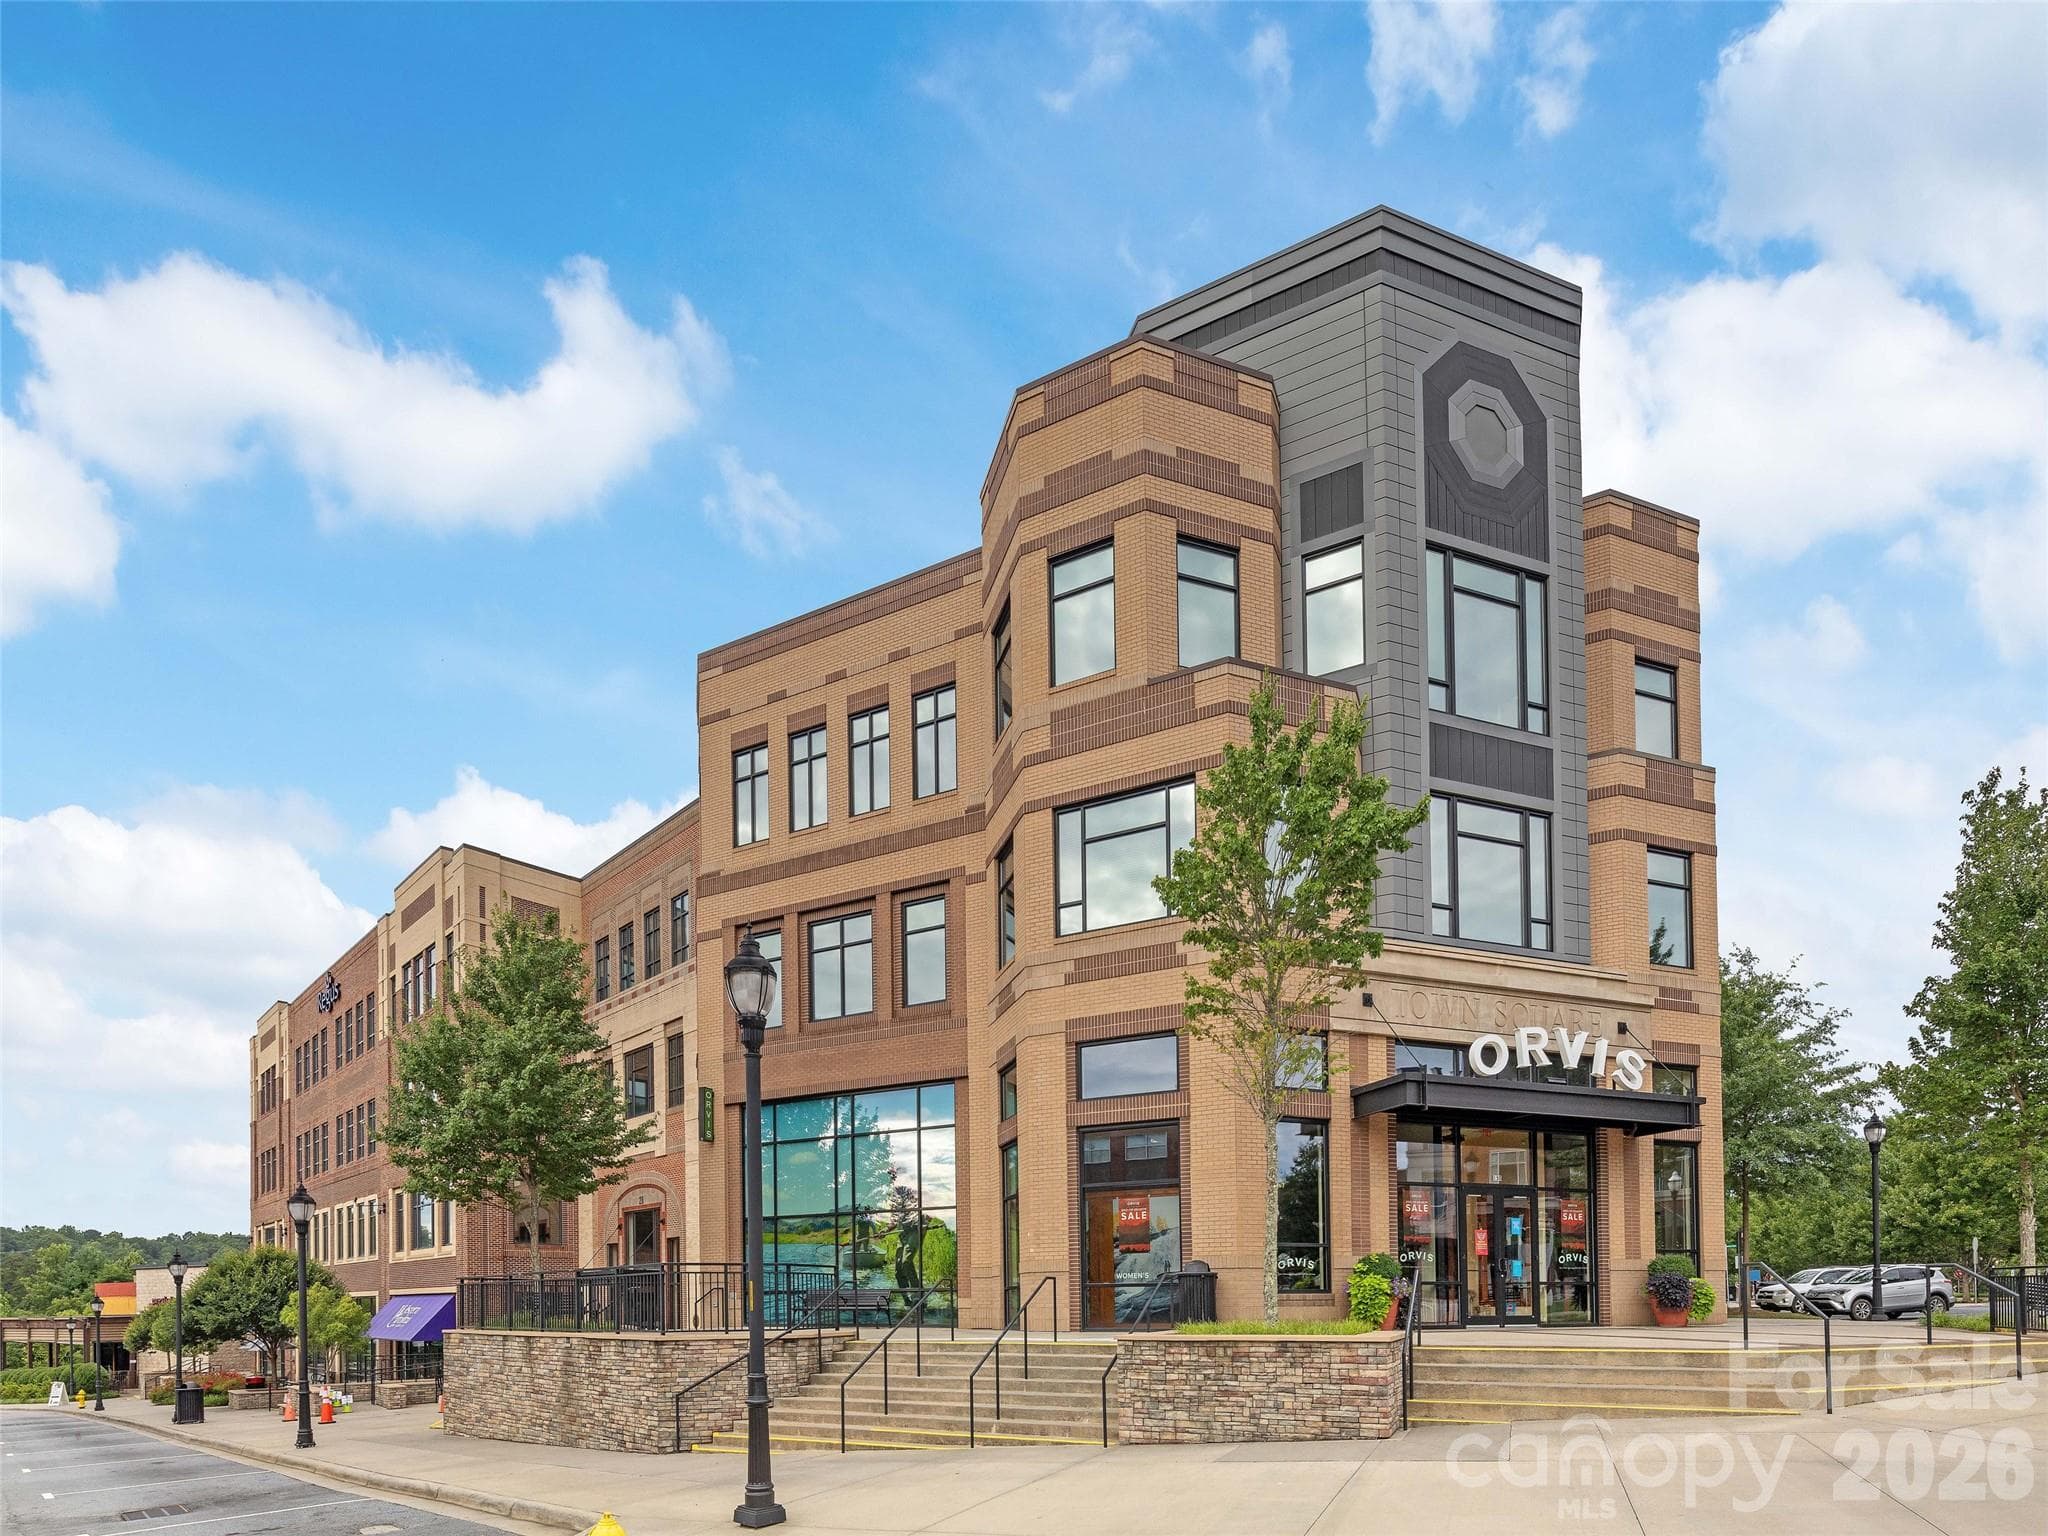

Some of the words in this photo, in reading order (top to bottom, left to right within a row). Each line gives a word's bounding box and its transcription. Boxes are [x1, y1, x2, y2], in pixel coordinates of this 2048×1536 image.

[1391, 988, 1480, 1025] TOWN
[1494, 1000, 1602, 1038] SQUARE
[1468, 1026, 1648, 1091] ORVIS
[1405, 1204, 1429, 1213] SALE
[1120, 1211, 1148, 1221] SALE
[1562, 1213, 1583, 1221] SALE
[1400, 1250, 1434, 1262] ORVIS
[1558, 1252, 1589, 1264] ORVIS
[1277, 1257, 1315, 1270] ORVIS
